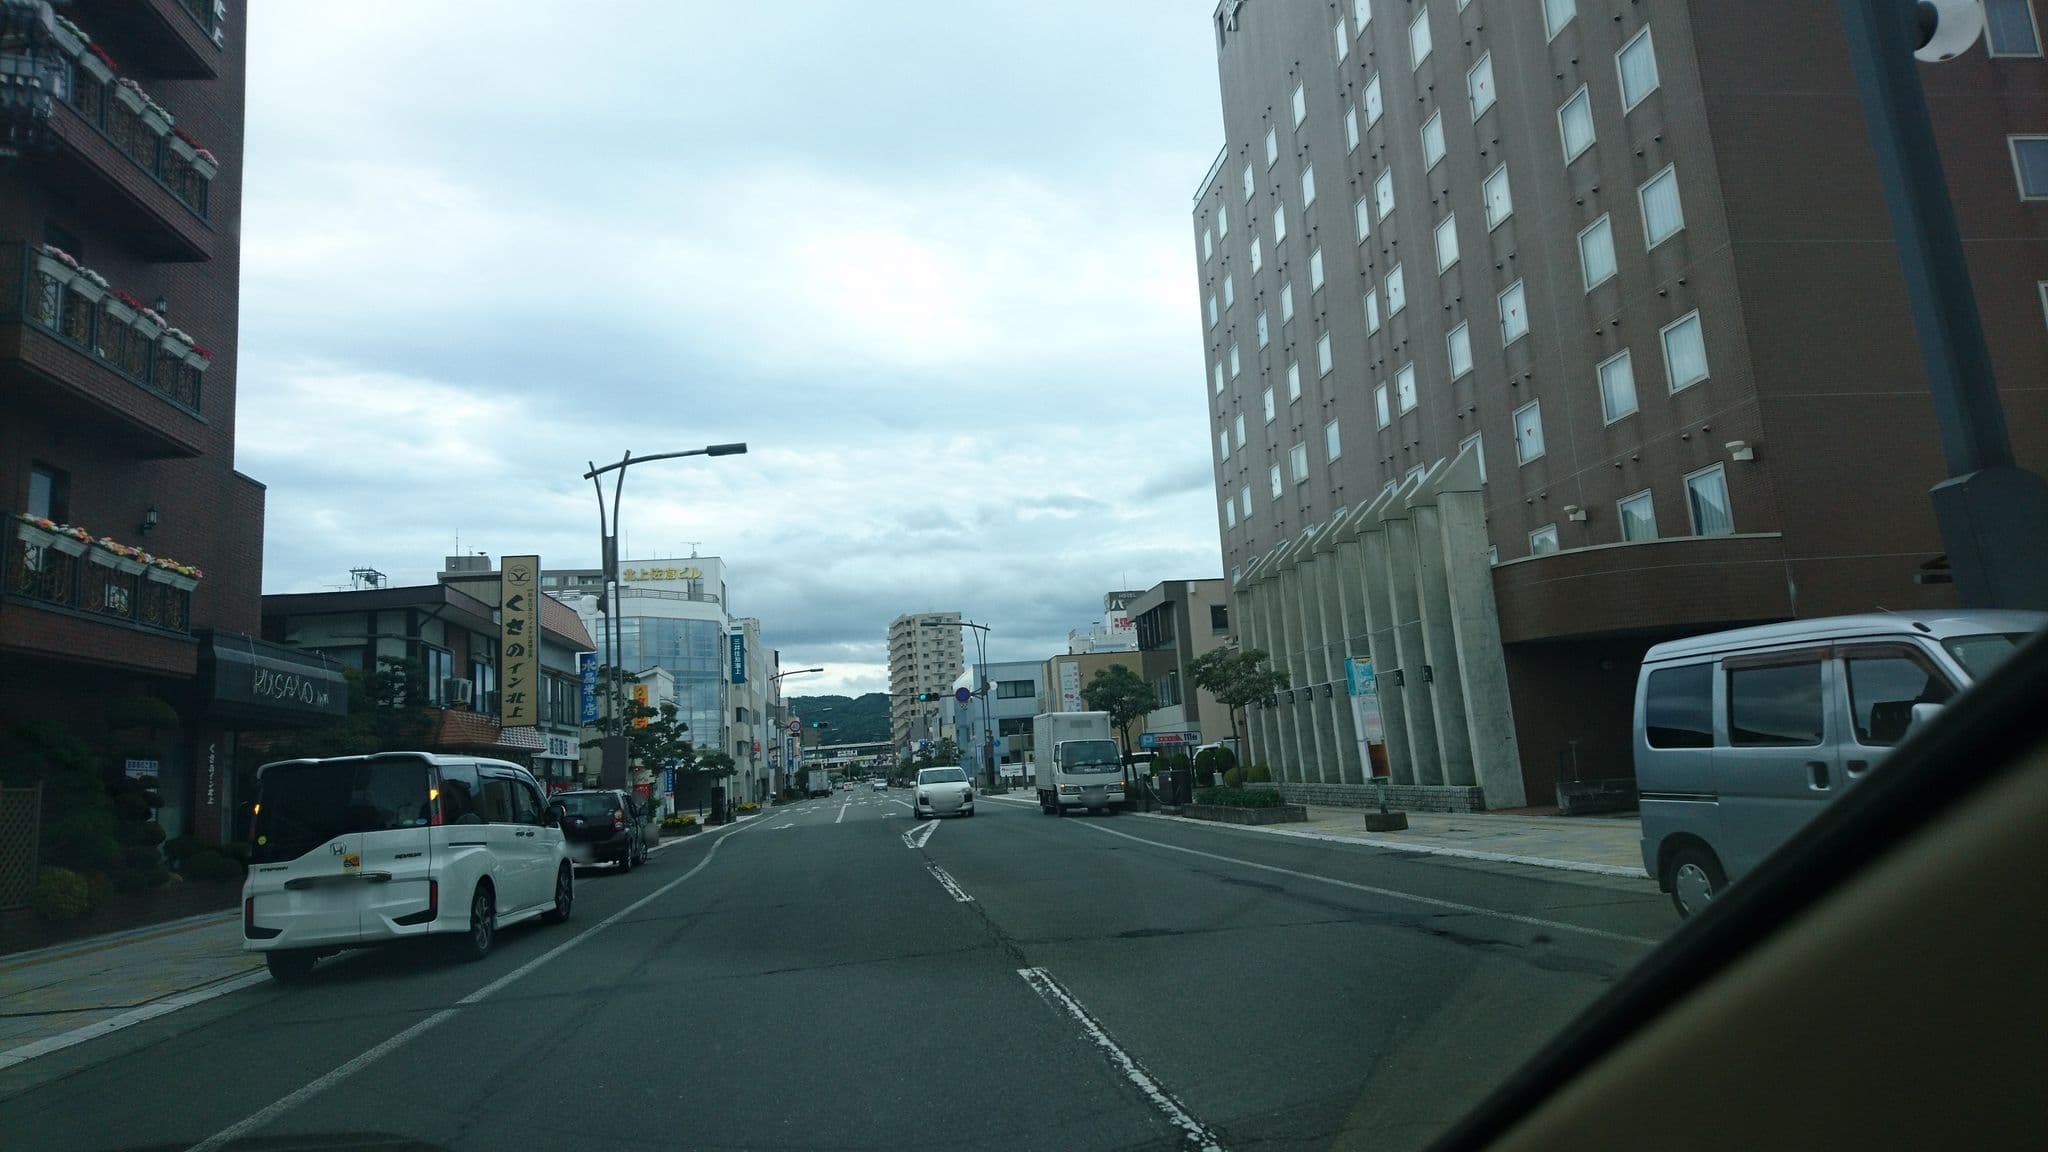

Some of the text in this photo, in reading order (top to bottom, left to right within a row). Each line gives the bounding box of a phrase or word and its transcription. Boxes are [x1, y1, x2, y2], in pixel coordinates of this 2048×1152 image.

[505, 594, 526, 718] くさのイン北上
